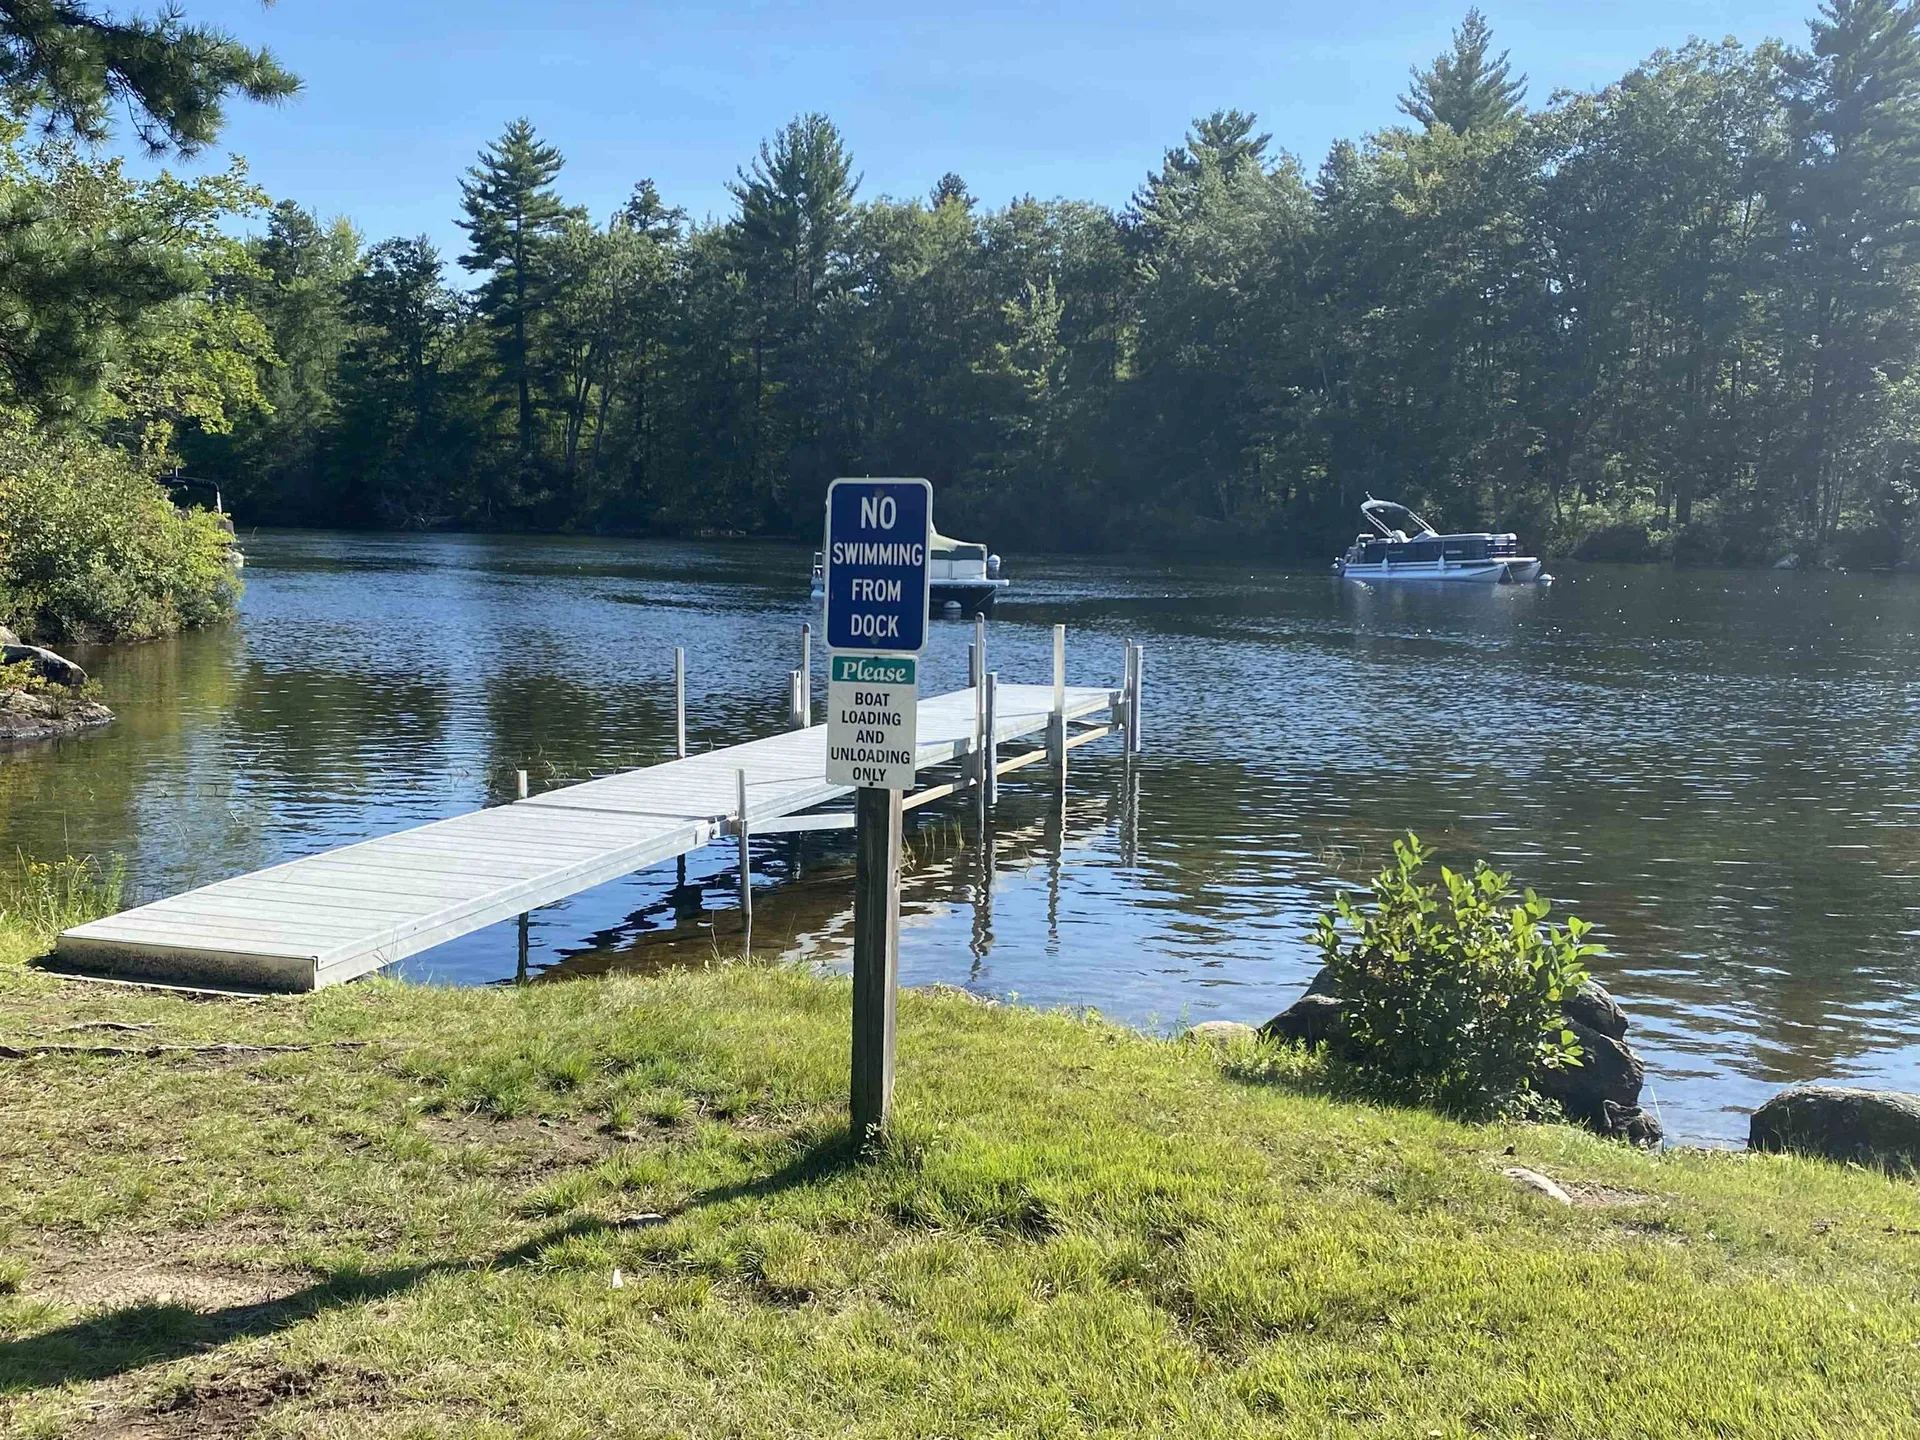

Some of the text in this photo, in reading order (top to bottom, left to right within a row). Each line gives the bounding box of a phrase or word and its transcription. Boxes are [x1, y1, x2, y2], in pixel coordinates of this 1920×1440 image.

[860, 496, 897, 530] NO
[832, 542, 923, 567] SWIMMING
[851, 579, 901, 602] FROM
[850, 614, 899, 638] DOCK
[841, 660, 907, 682] Please
[855, 692, 890, 707] BOAT
[841, 710, 902, 726] LOADING
[856, 730, 884, 744] AND
[831, 747, 910, 764] UNLOADING
[852, 767, 887, 782] ONLY
